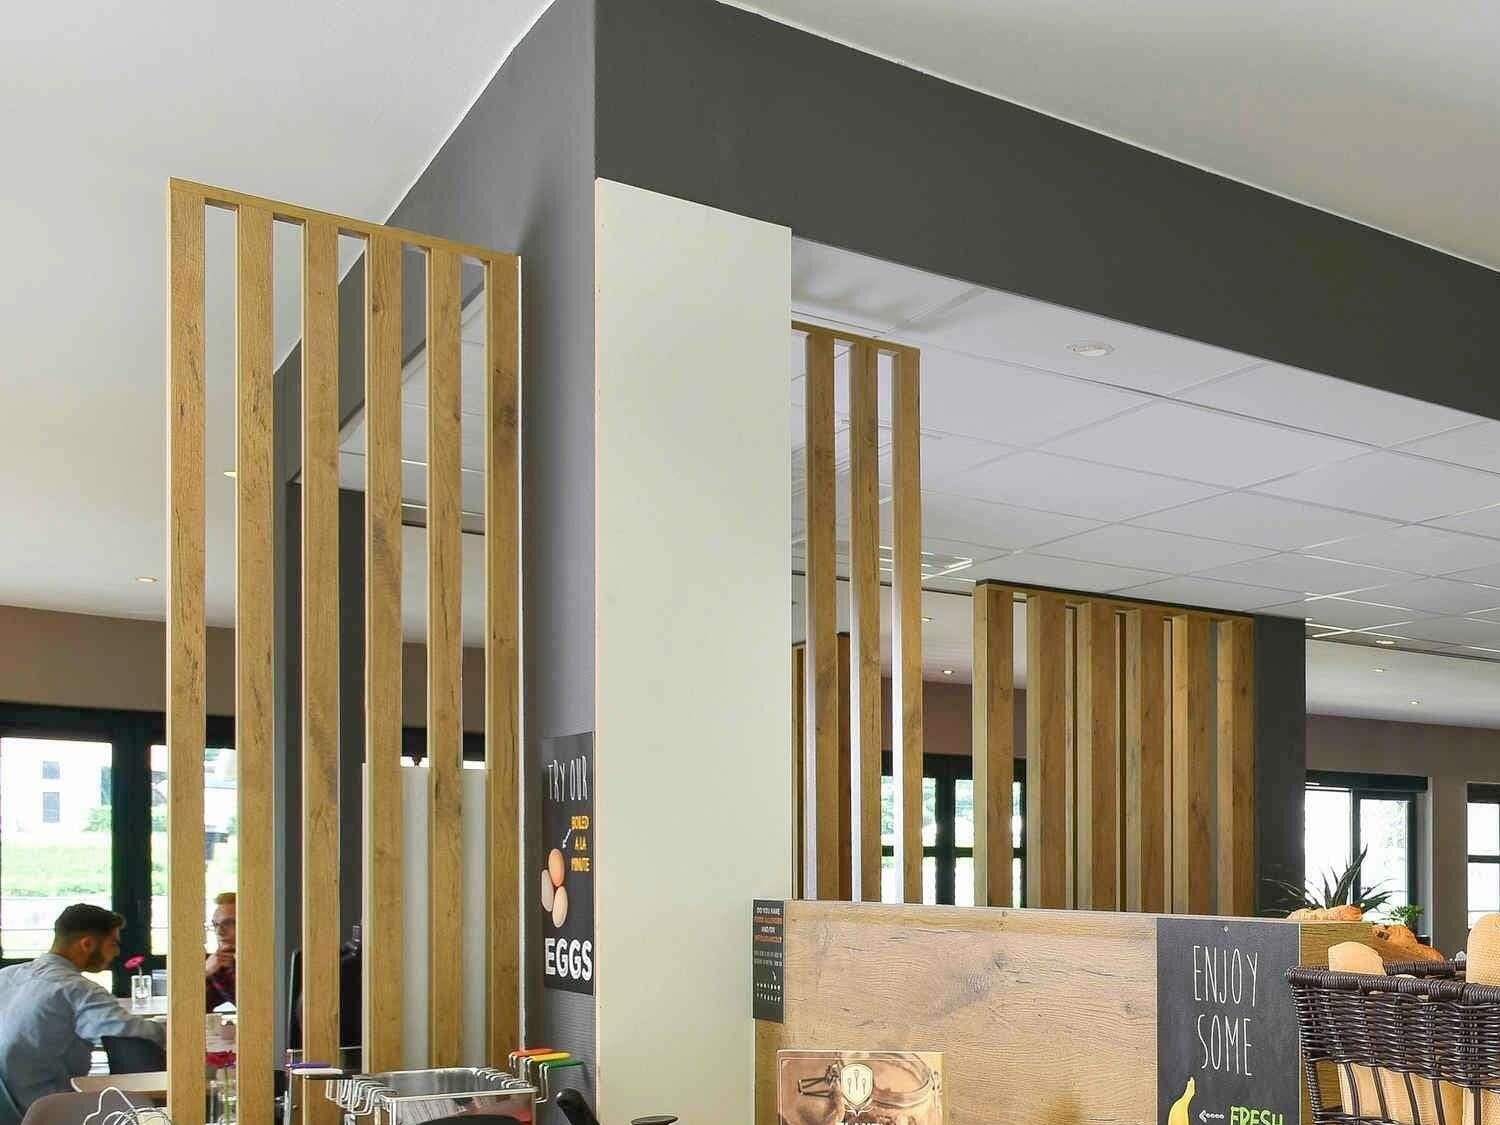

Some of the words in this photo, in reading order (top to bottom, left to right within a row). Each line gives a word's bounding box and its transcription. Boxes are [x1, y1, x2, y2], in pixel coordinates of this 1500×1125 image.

[548, 760, 566, 801] TRY
[570, 755, 588, 801] OUR
[545, 937, 593, 981] EGGS
[1193, 945, 1258, 1008] ENJOY
[1197, 1014, 1253, 1076] SOME
